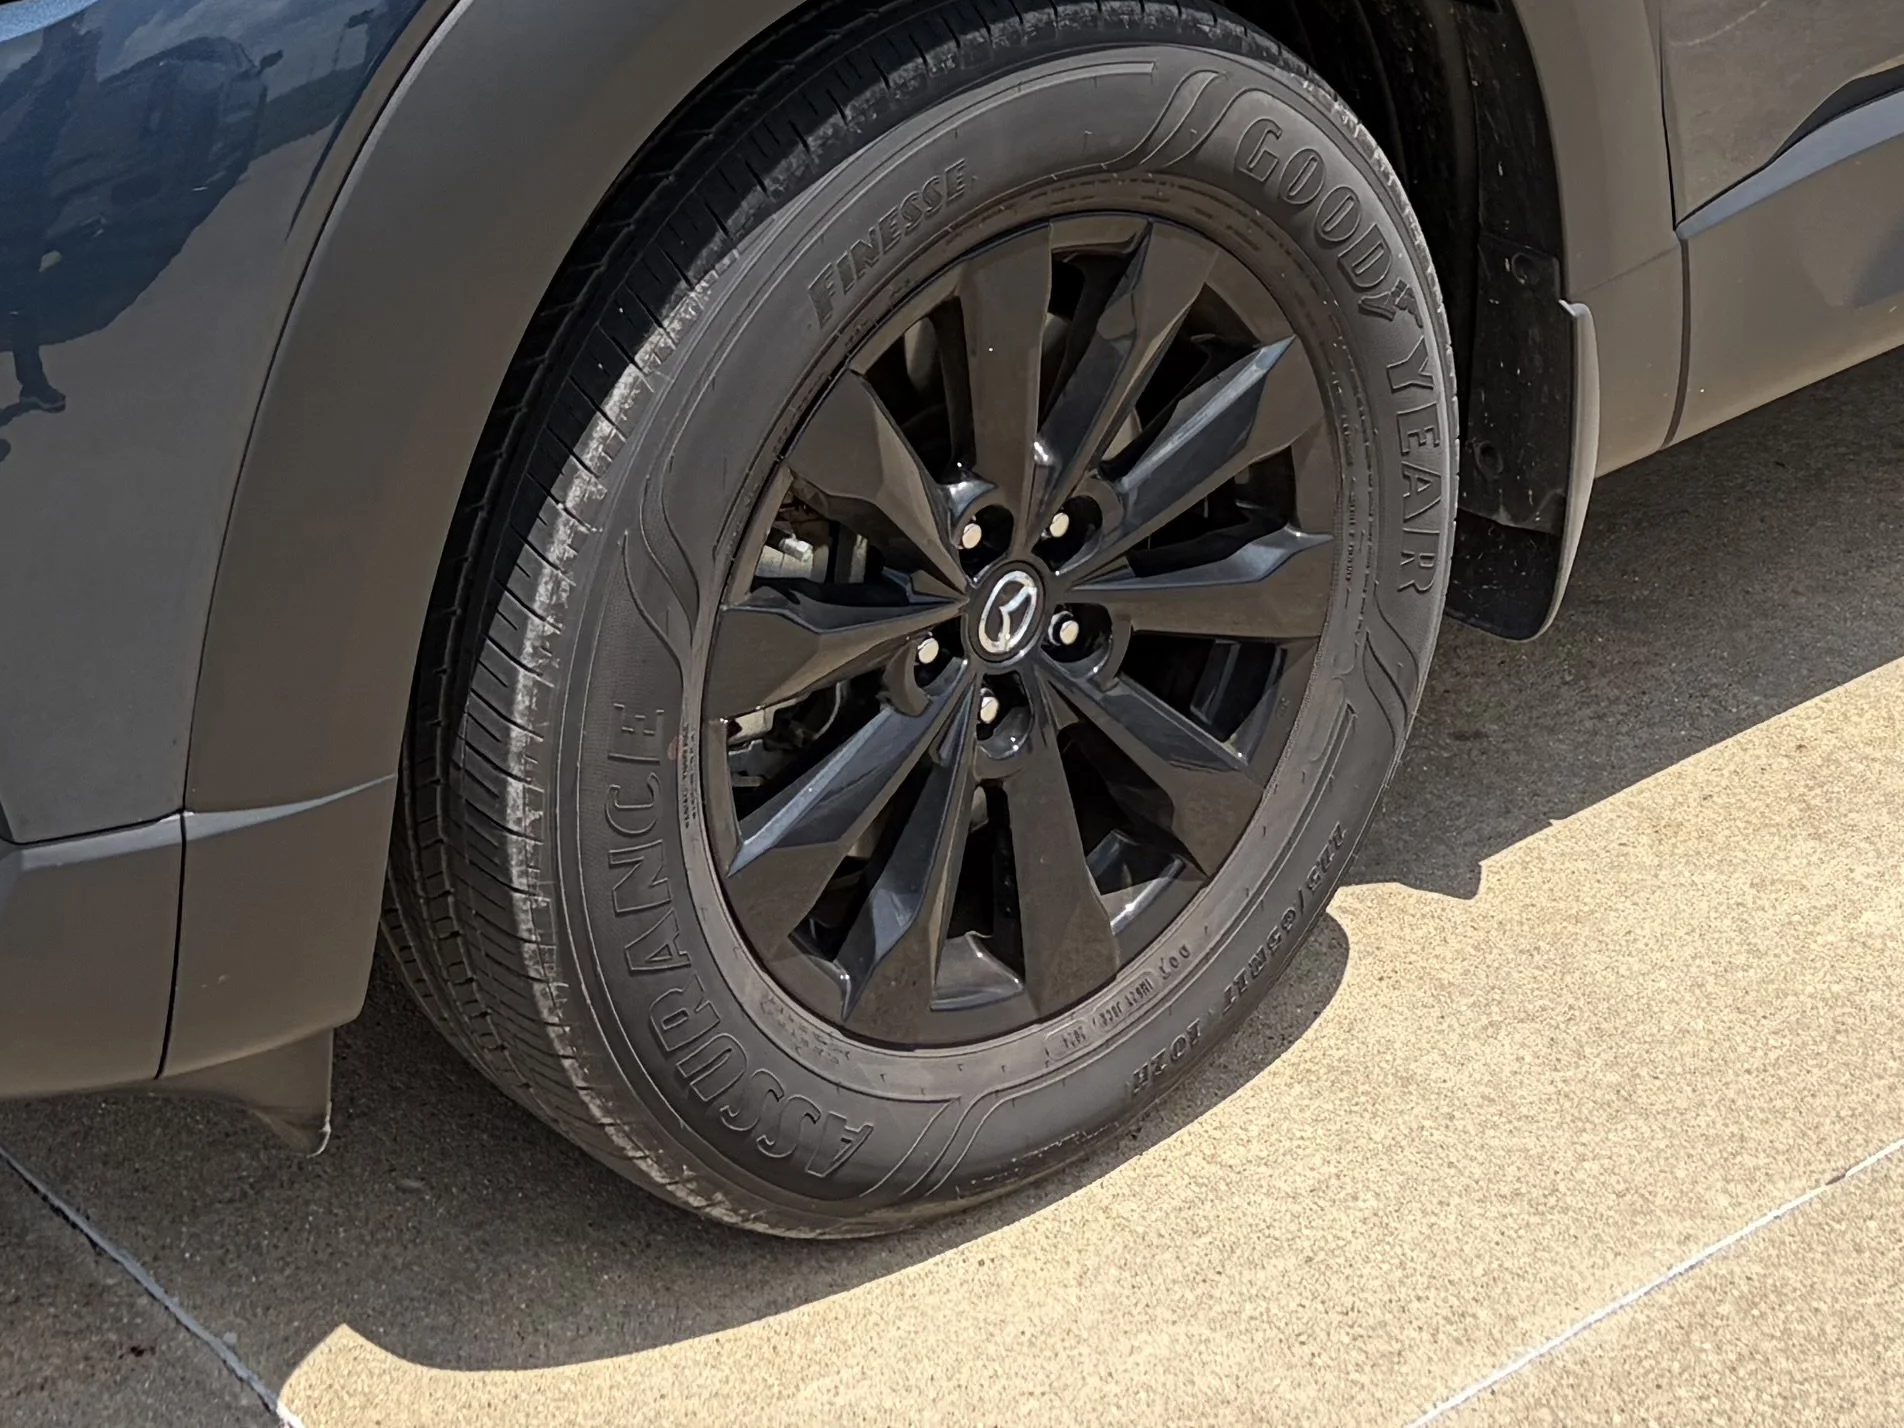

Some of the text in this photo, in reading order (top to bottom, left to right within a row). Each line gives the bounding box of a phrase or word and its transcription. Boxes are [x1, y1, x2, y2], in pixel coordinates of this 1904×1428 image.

[807, 157, 966, 329] FINESSE
[1234, 116, 1444, 595] GOODYEAR
[604, 702, 874, 1179] ASSURANCE
